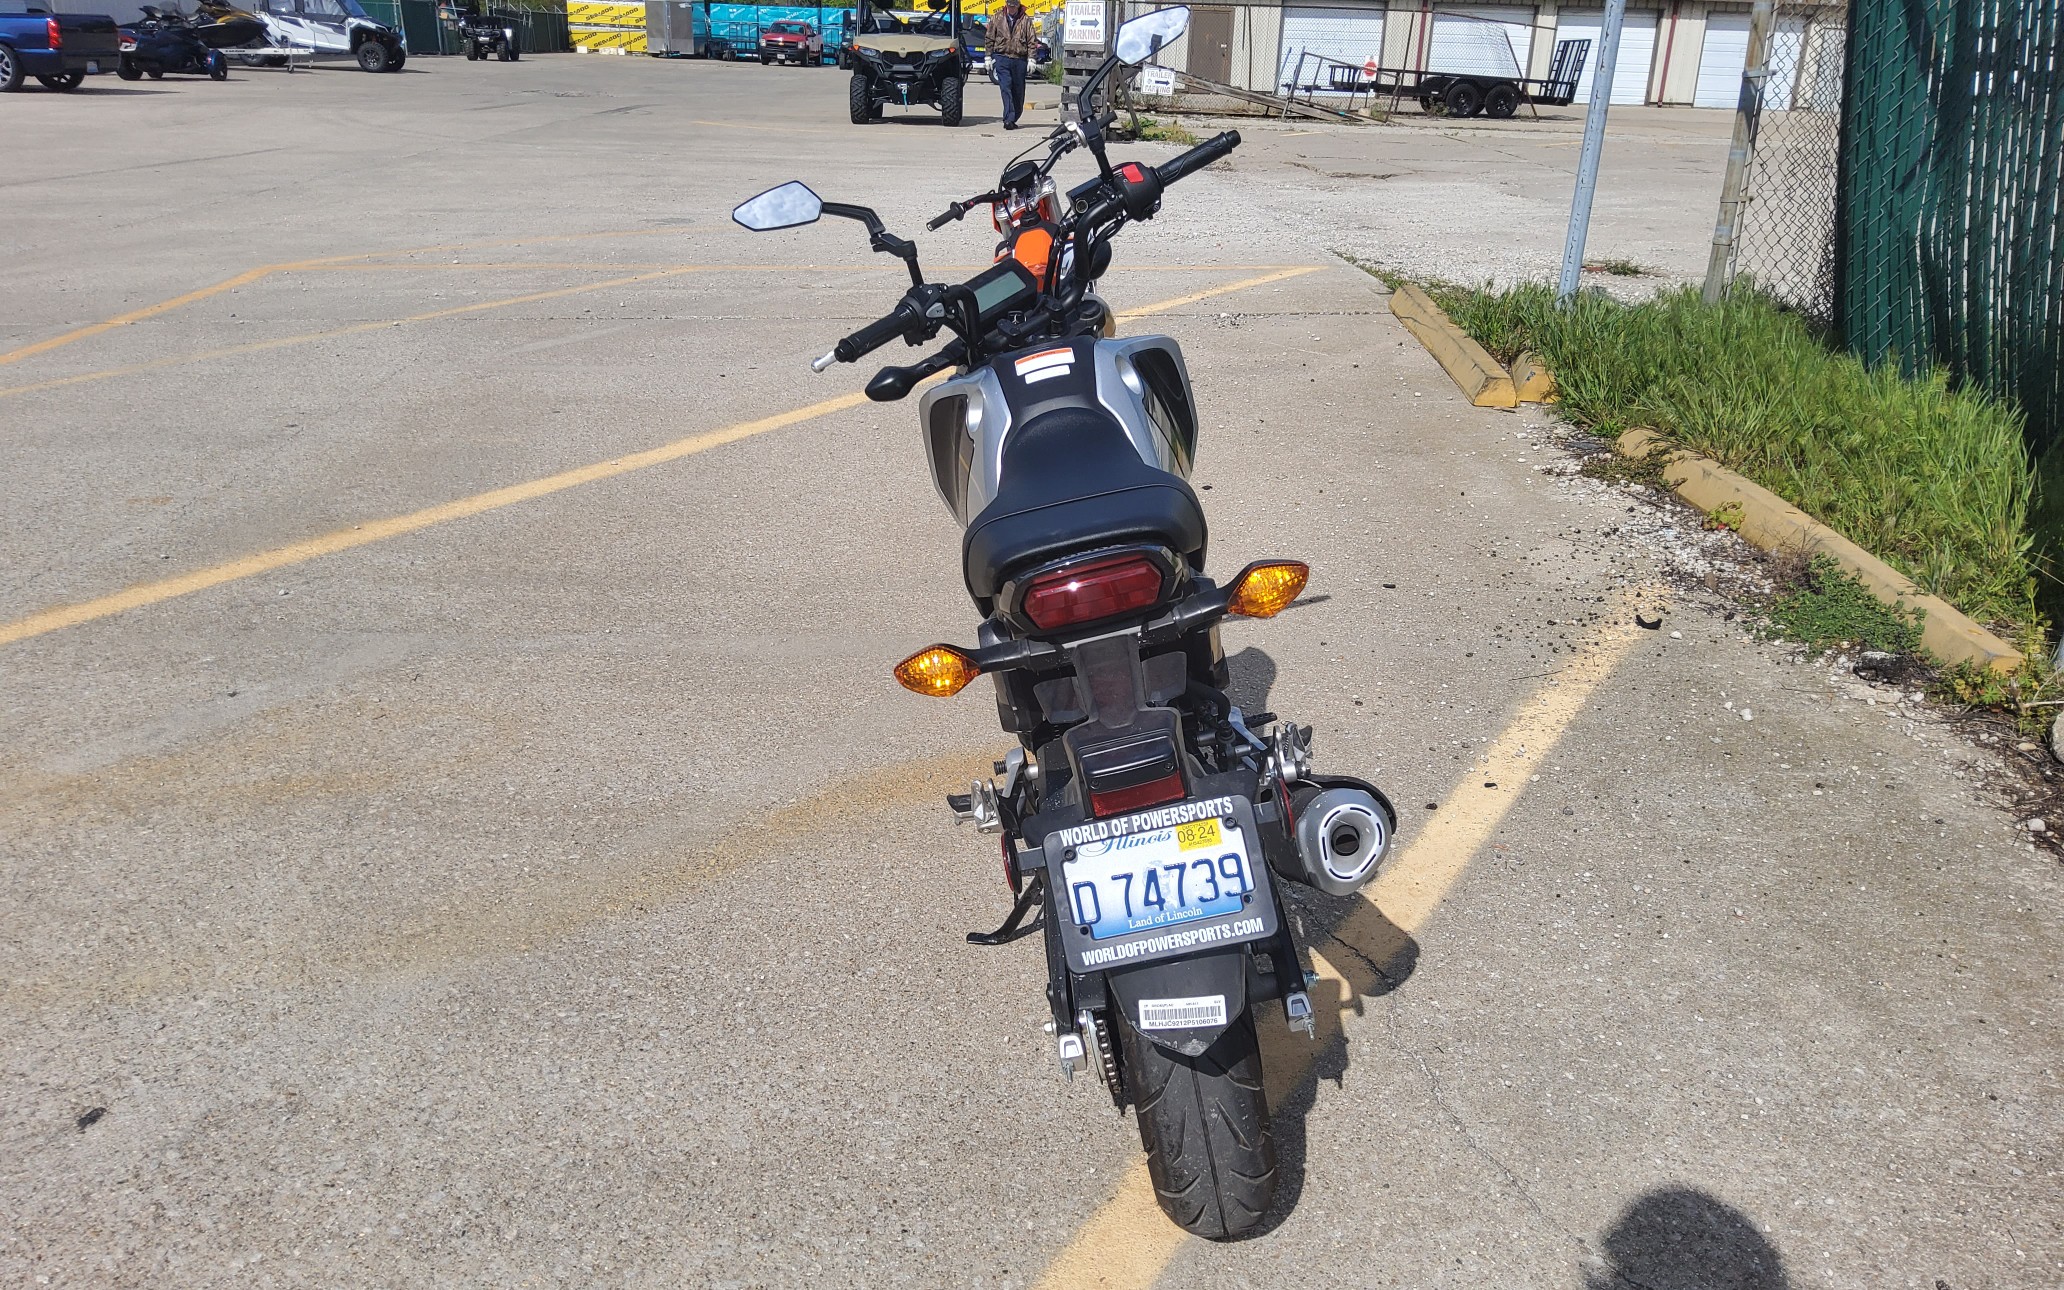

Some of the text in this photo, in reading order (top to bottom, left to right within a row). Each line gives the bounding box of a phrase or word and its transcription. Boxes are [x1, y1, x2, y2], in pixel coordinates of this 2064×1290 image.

[1070, 4, 1101, 16] TRAILER
[1068, 29, 1101, 40] PARKING
[1147, 70, 1172, 80] TRAILER
[1059, 796, 1234, 847] WORLD OF POWERSPORTS
[1079, 829, 1173, 857] Illinois
[1111, 852, 1247, 918] 74739
[1128, 906, 1204, 929] Land of Lincoln
[1081, 917, 1265, 967] WORLDOFPOWERSPORTS.COM
